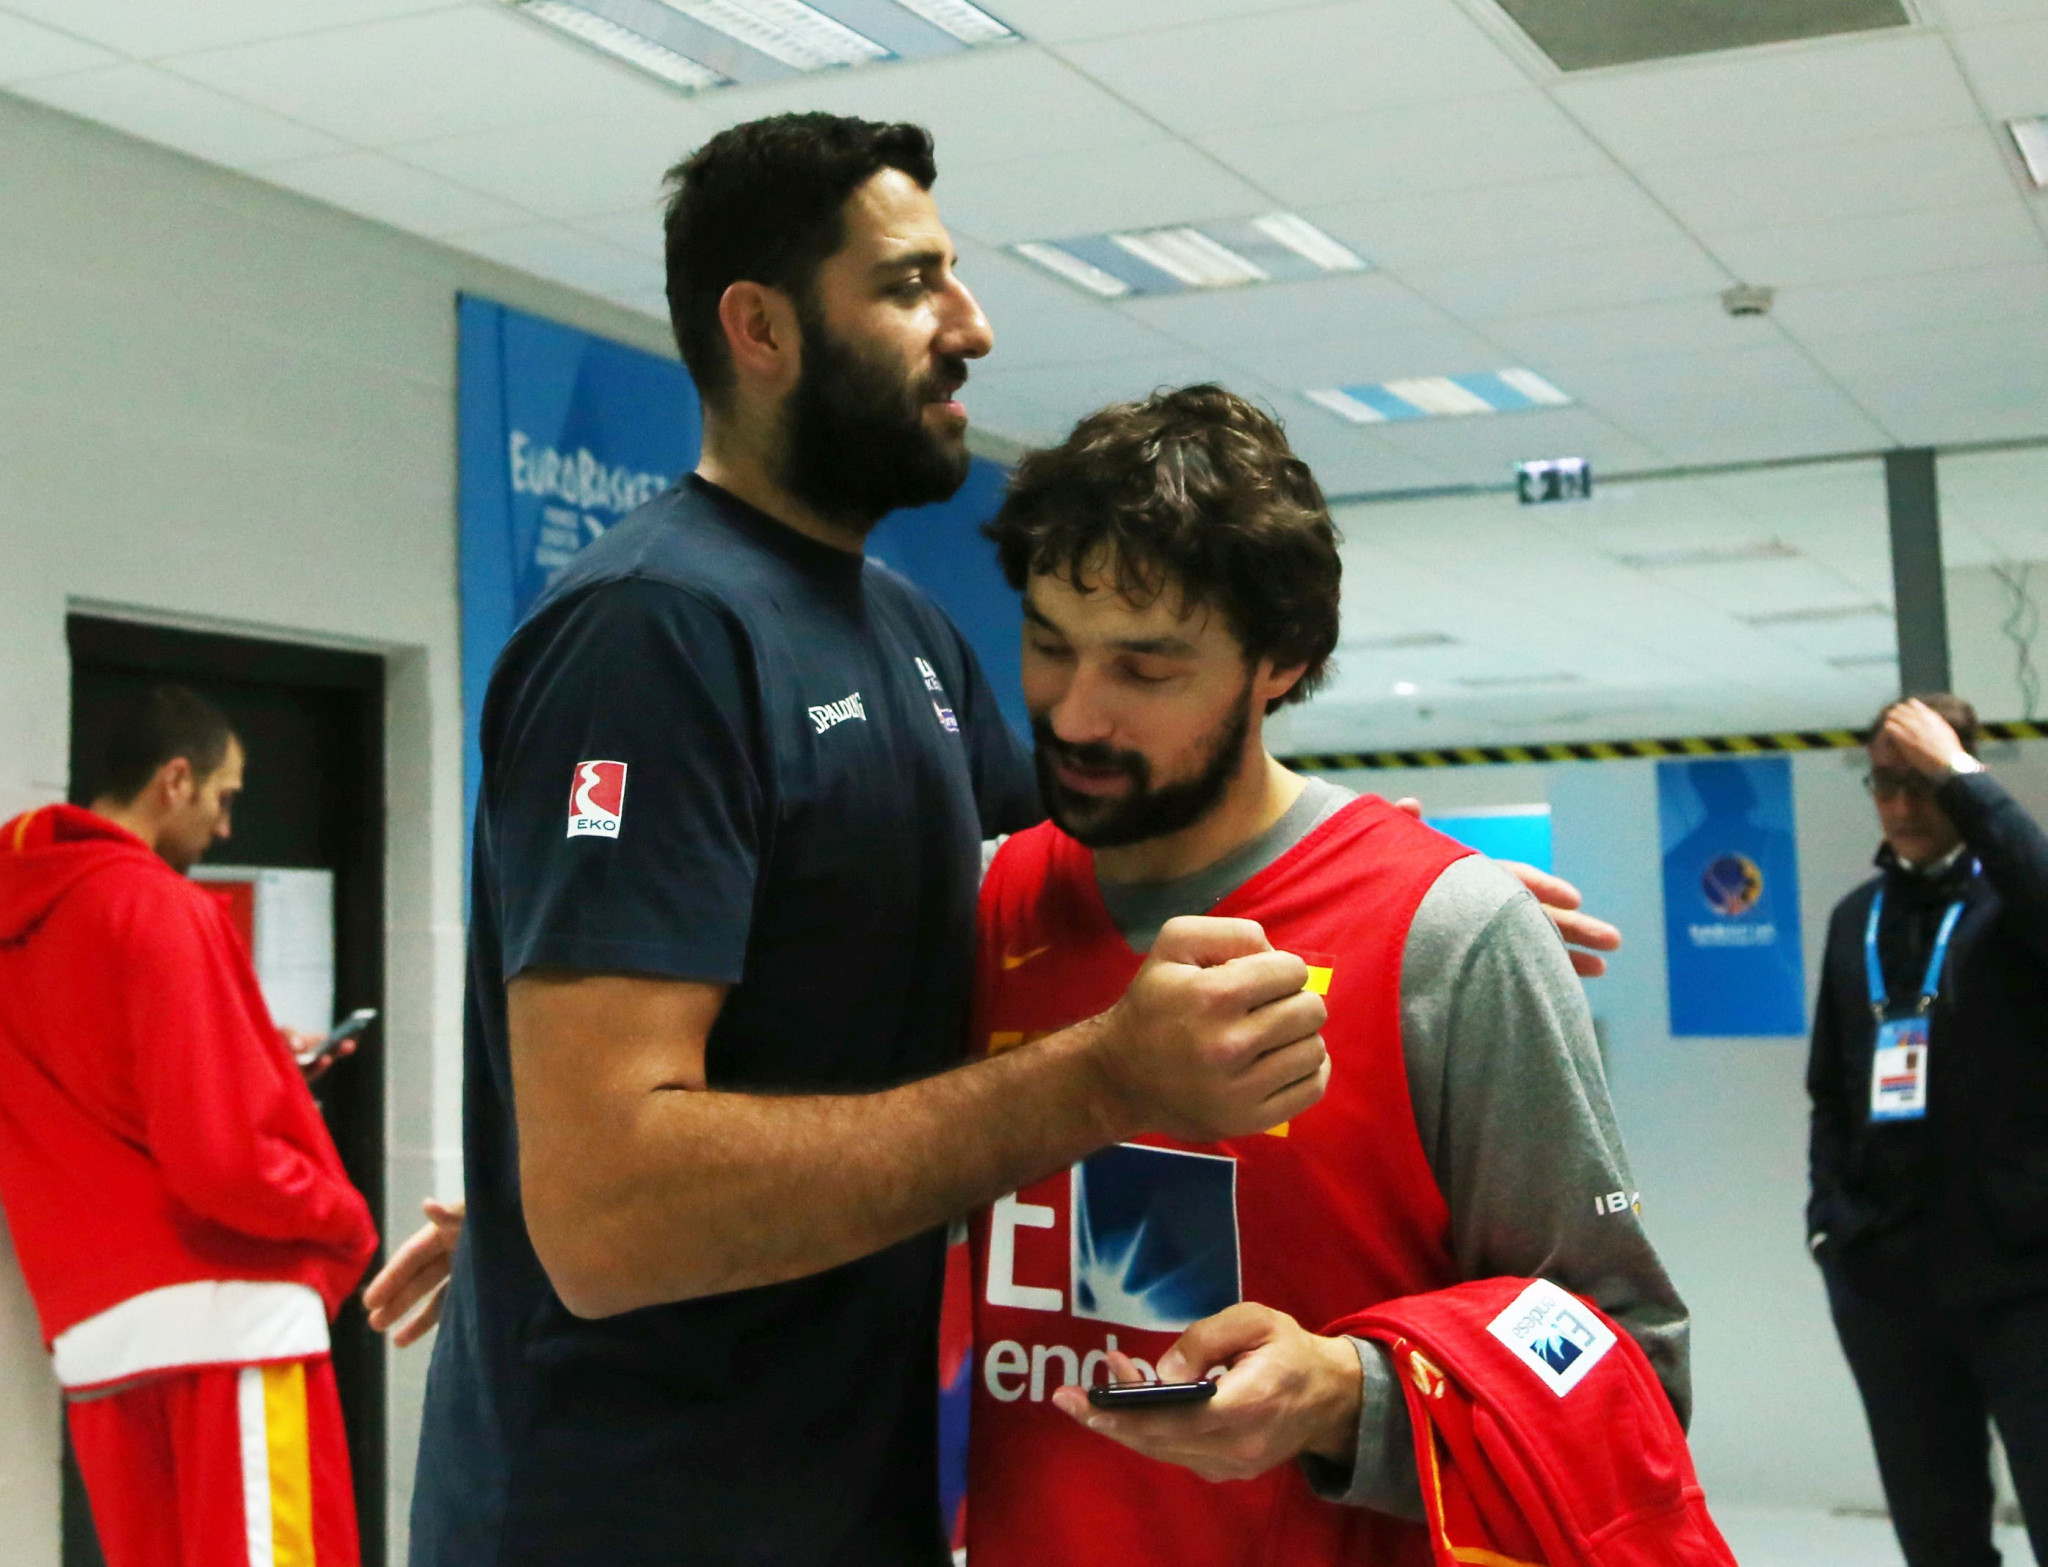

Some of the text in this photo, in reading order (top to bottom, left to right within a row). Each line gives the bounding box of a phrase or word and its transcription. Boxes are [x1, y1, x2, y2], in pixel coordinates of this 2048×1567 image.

[808, 691, 867, 735] SPALDING
[577, 819, 616, 831] EKO
[1512, 1295, 1556, 1339] endesa
